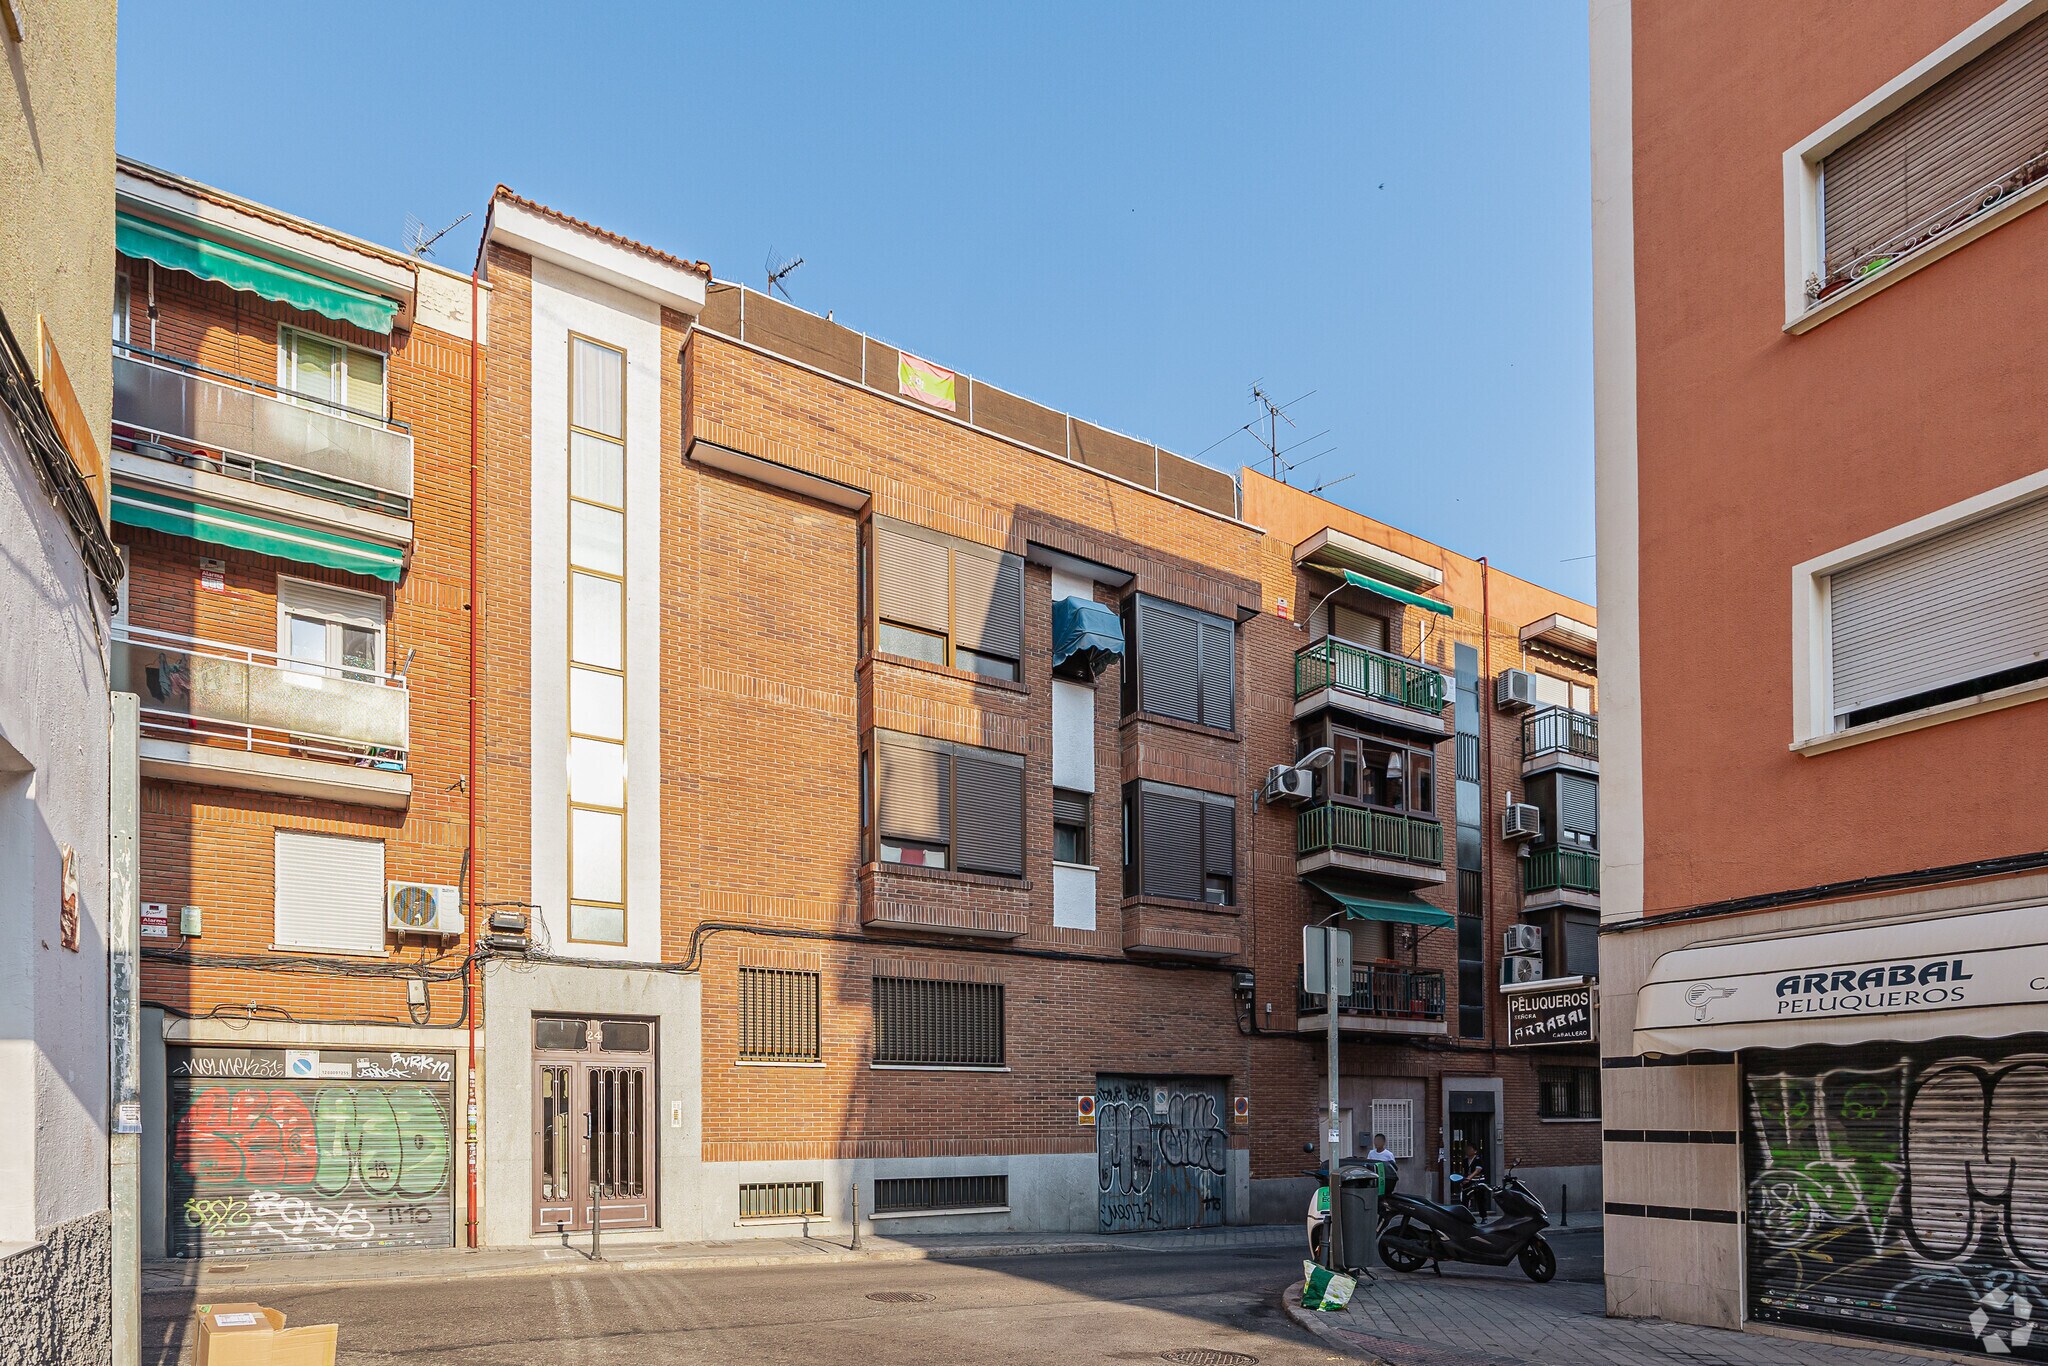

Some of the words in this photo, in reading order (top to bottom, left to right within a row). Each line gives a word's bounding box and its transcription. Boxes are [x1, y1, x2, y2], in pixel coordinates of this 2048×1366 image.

[1775, 959, 1974, 998] ARRABAL
[1511, 992, 1589, 1012] PELUQUEROS
[1777, 986, 1966, 1015] PELUQUEROS
[587, 1031, 602, 1041] 24
[1514, 1008, 1587, 1040] ARRABAL
[1552, 1030, 1588, 1038] CABALLERO
